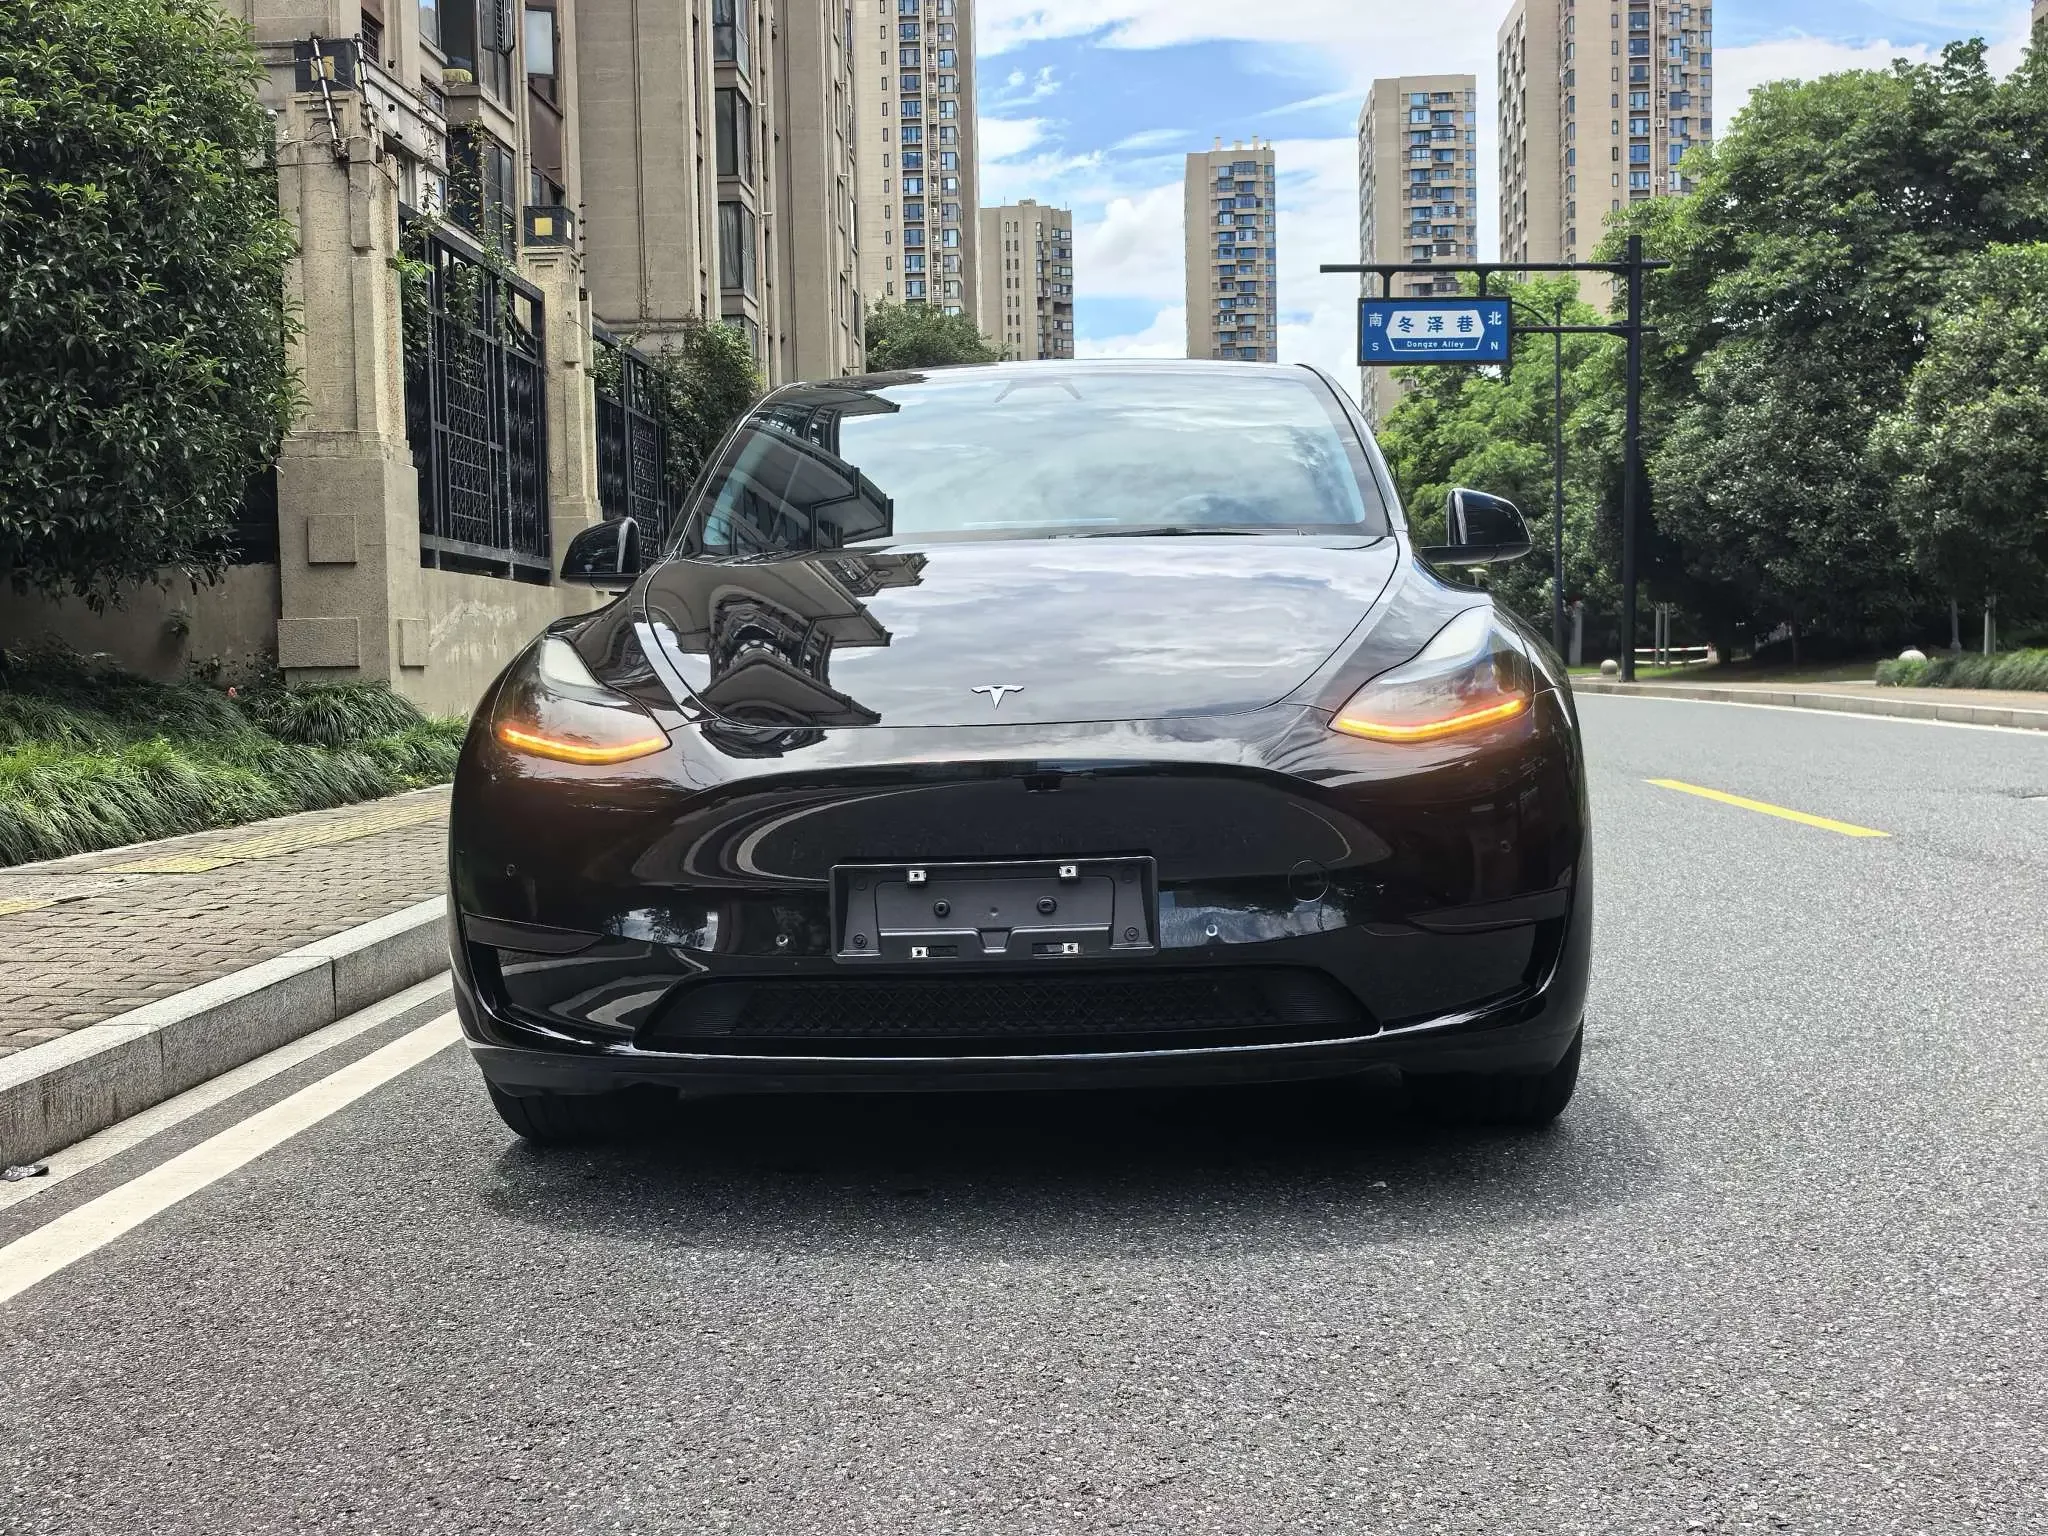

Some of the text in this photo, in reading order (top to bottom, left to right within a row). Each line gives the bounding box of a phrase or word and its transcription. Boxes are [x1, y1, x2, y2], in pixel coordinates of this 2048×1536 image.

[1369, 312, 1383, 327] 南
[1397, 315, 1474, 333] 冬泽巷
[1488, 311, 1502, 326] 北
[1371, 342, 1380, 351] S
[1406, 340, 1465, 349] Dongze Alley
[1490, 341, 1499, 350] N
